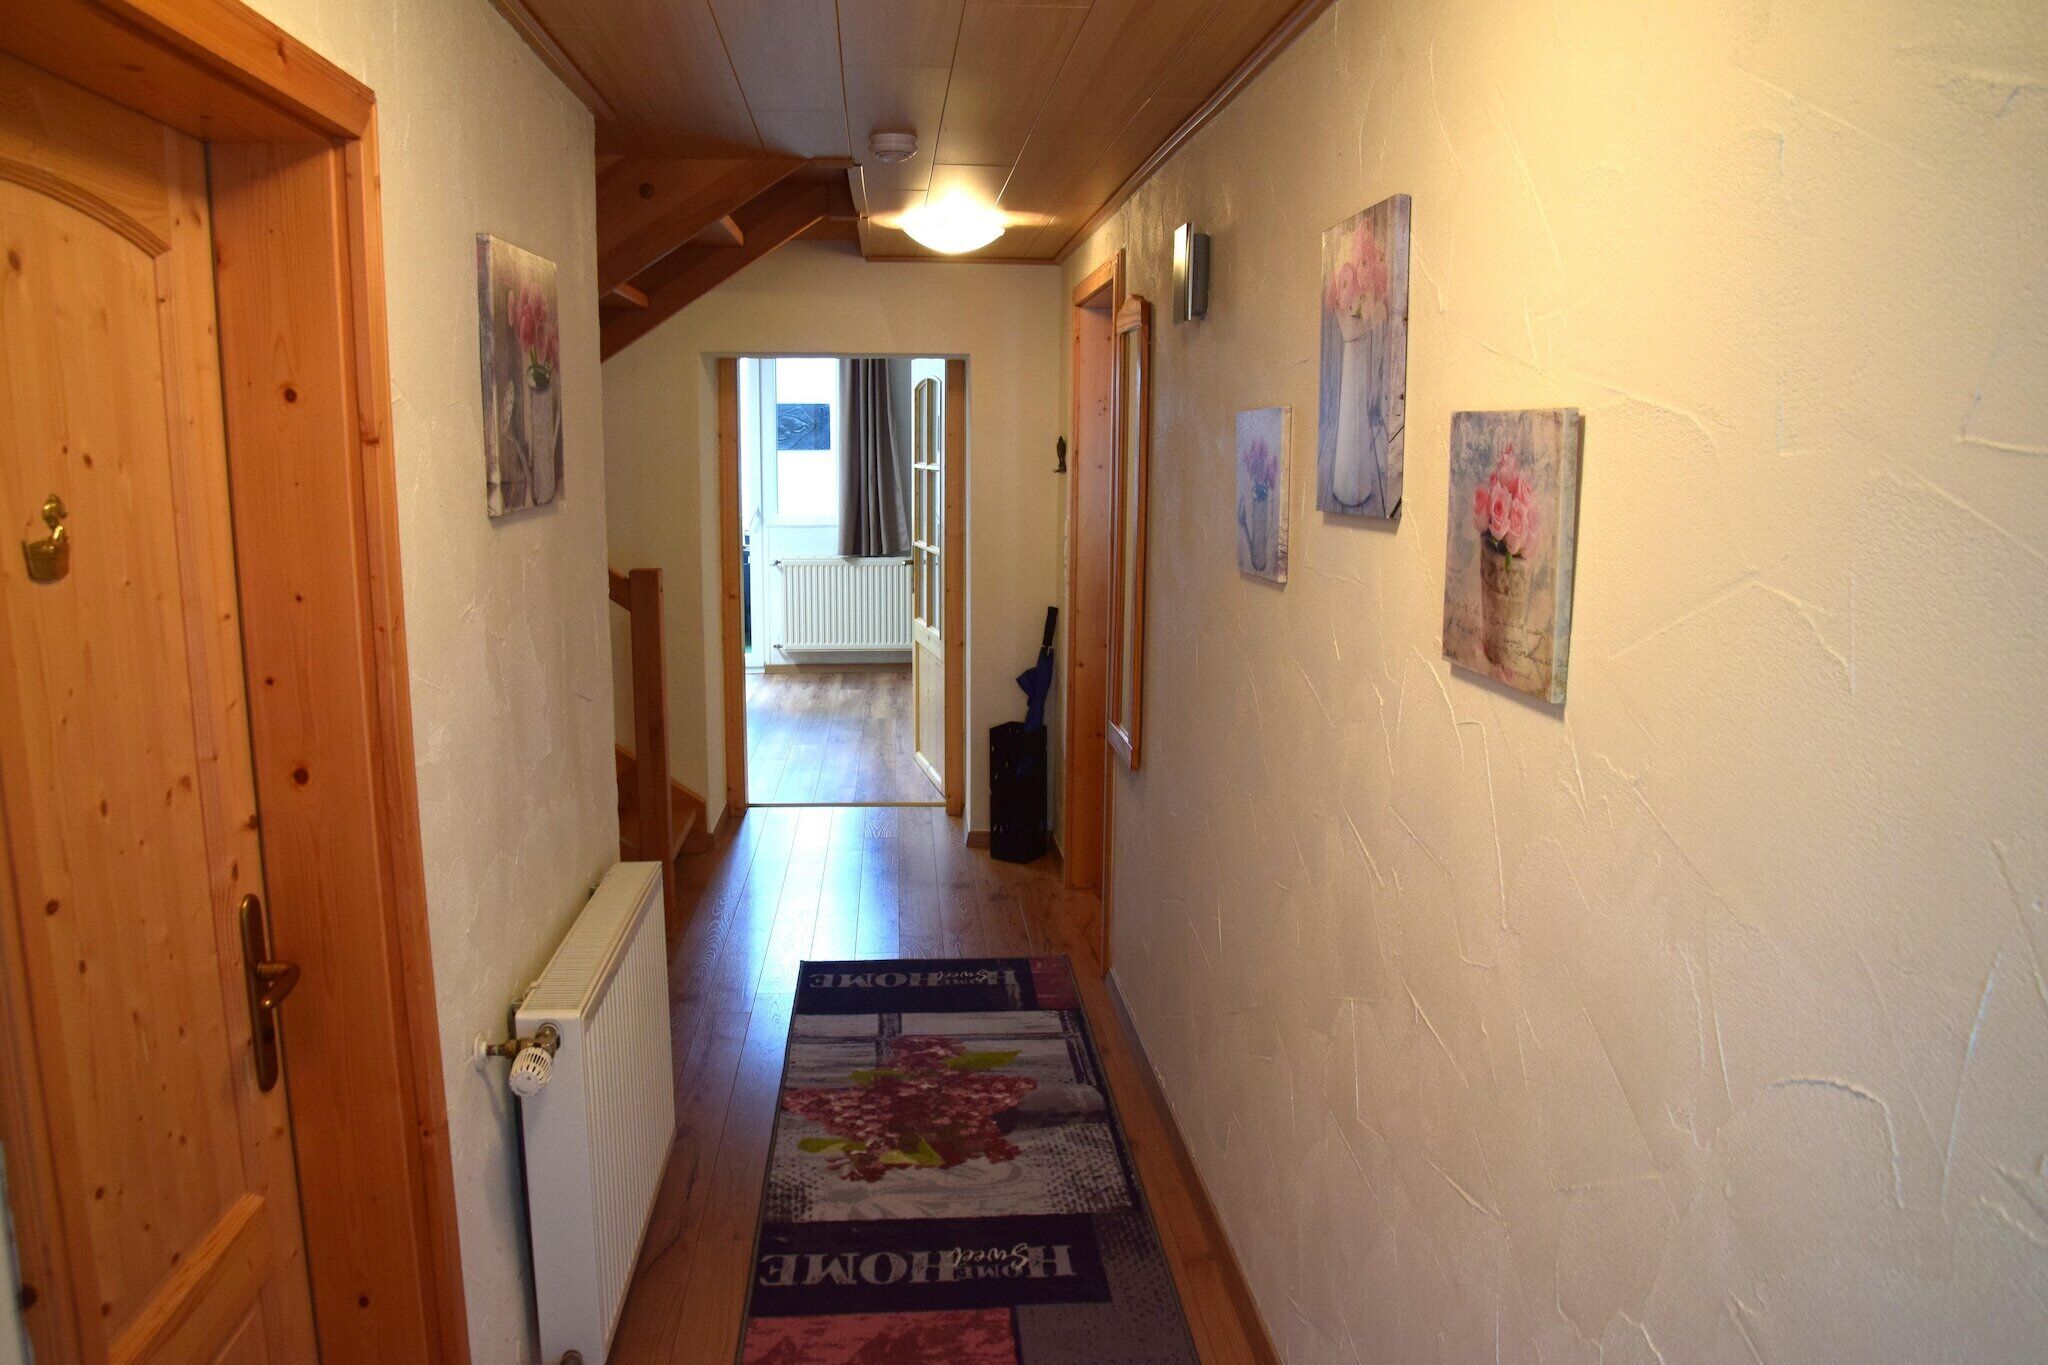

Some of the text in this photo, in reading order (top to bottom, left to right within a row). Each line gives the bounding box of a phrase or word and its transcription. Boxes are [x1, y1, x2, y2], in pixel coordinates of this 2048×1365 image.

[809, 972, 943, 988] HOME
[759, 1250, 959, 1287] HOME
[951, 1243, 1028, 1270] Sweet
